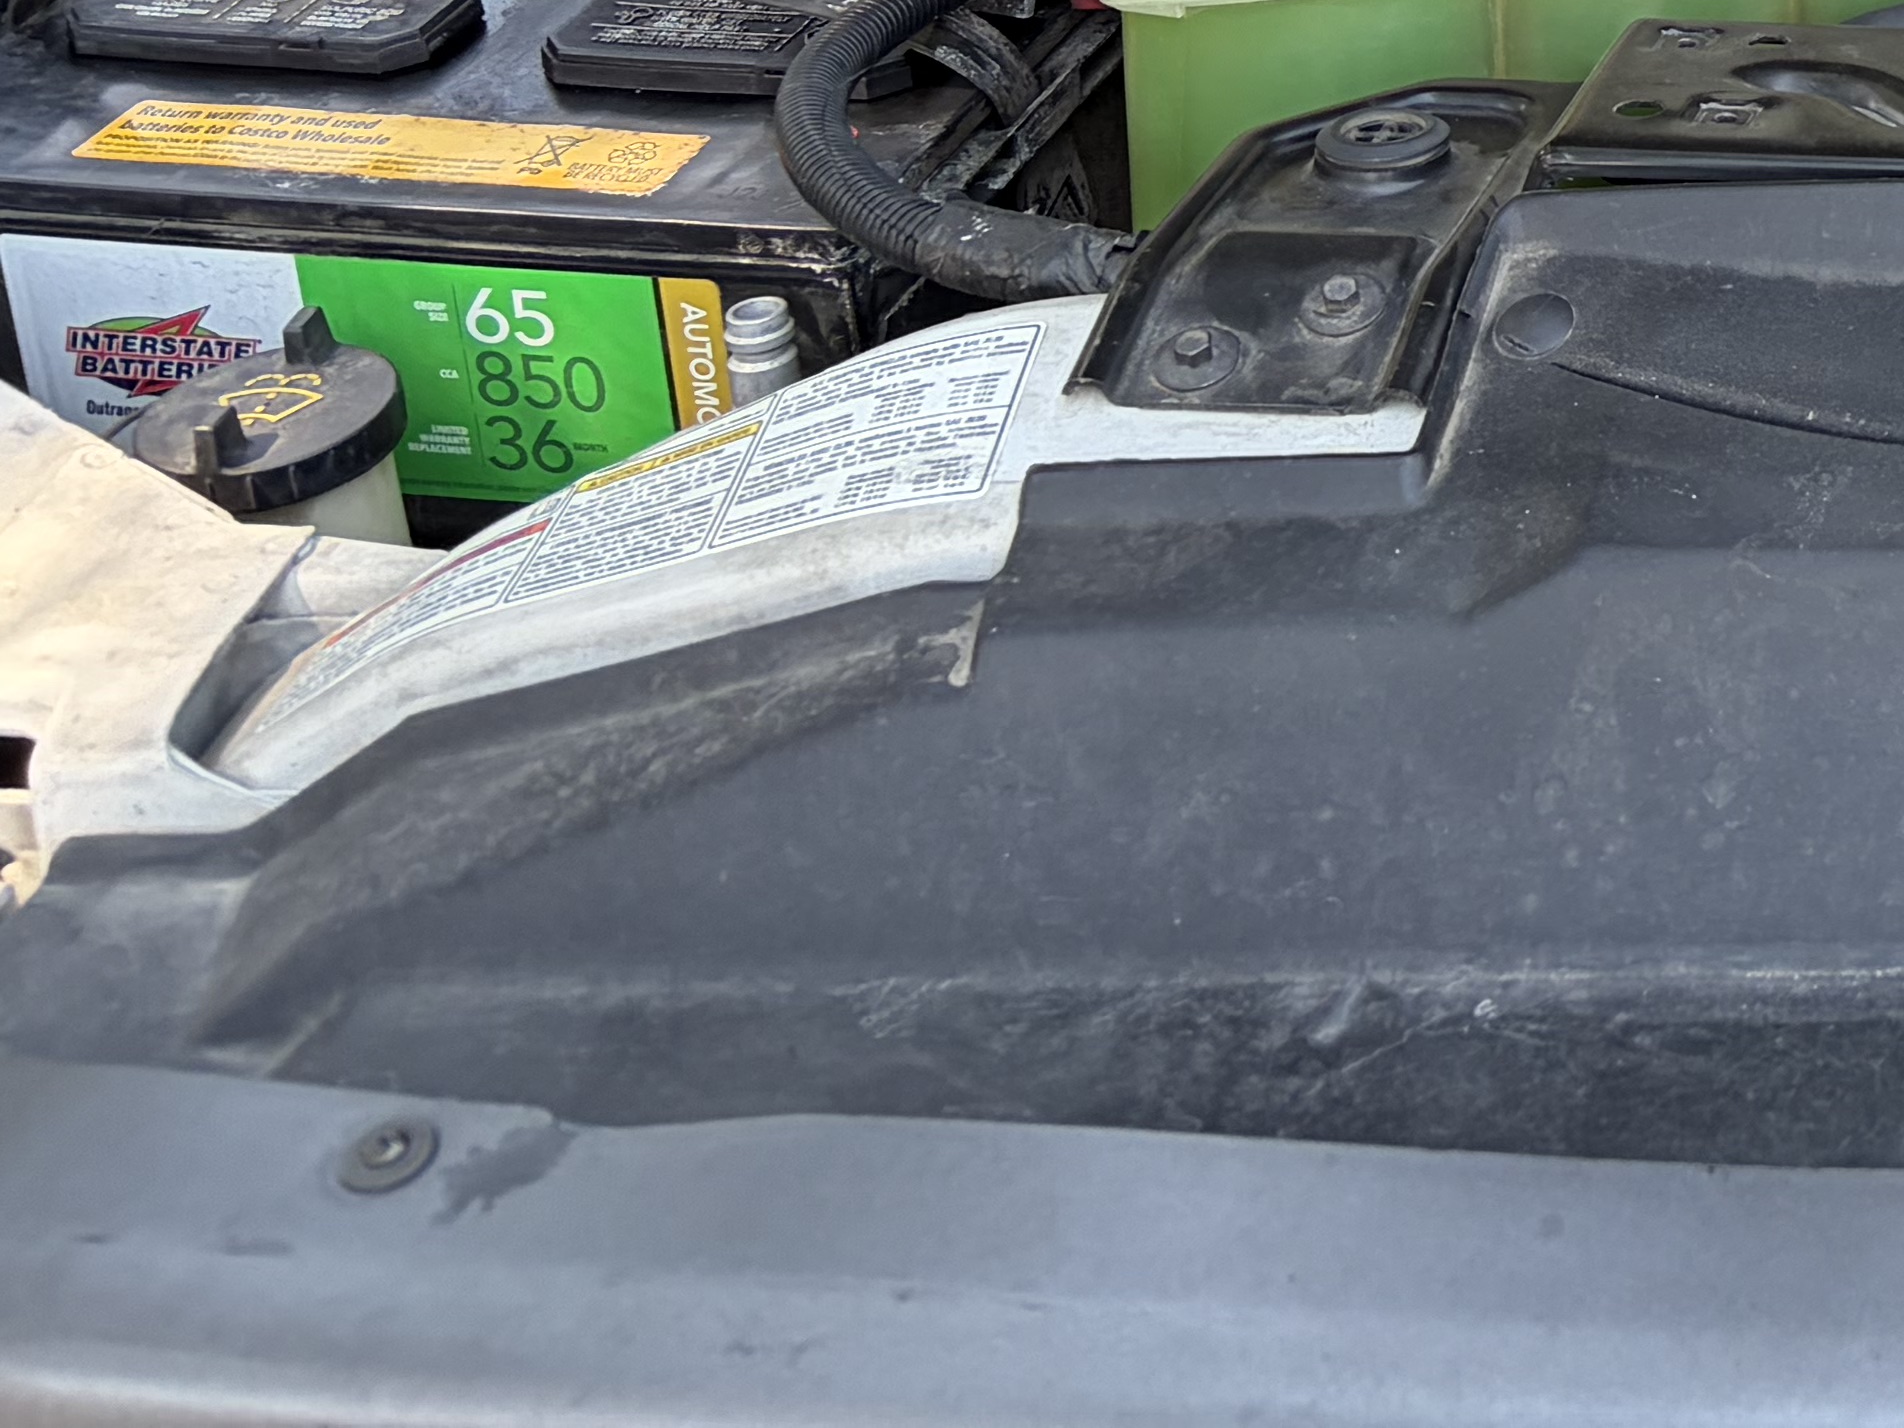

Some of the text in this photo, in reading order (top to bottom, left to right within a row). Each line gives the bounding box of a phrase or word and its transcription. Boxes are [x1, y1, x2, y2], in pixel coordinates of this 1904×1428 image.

[119, 118, 391, 144] batteries to Costco Wholesale
[136, 105, 383, 130] Return warranty and used
[465, 287, 555, 347] 65
[71, 331, 256, 359] INTERSTATE
[439, 369, 459, 379] CCA
[475, 350, 607, 413] 850
[484, 414, 574, 474] 36
[573, 442, 609, 453] MONTH
